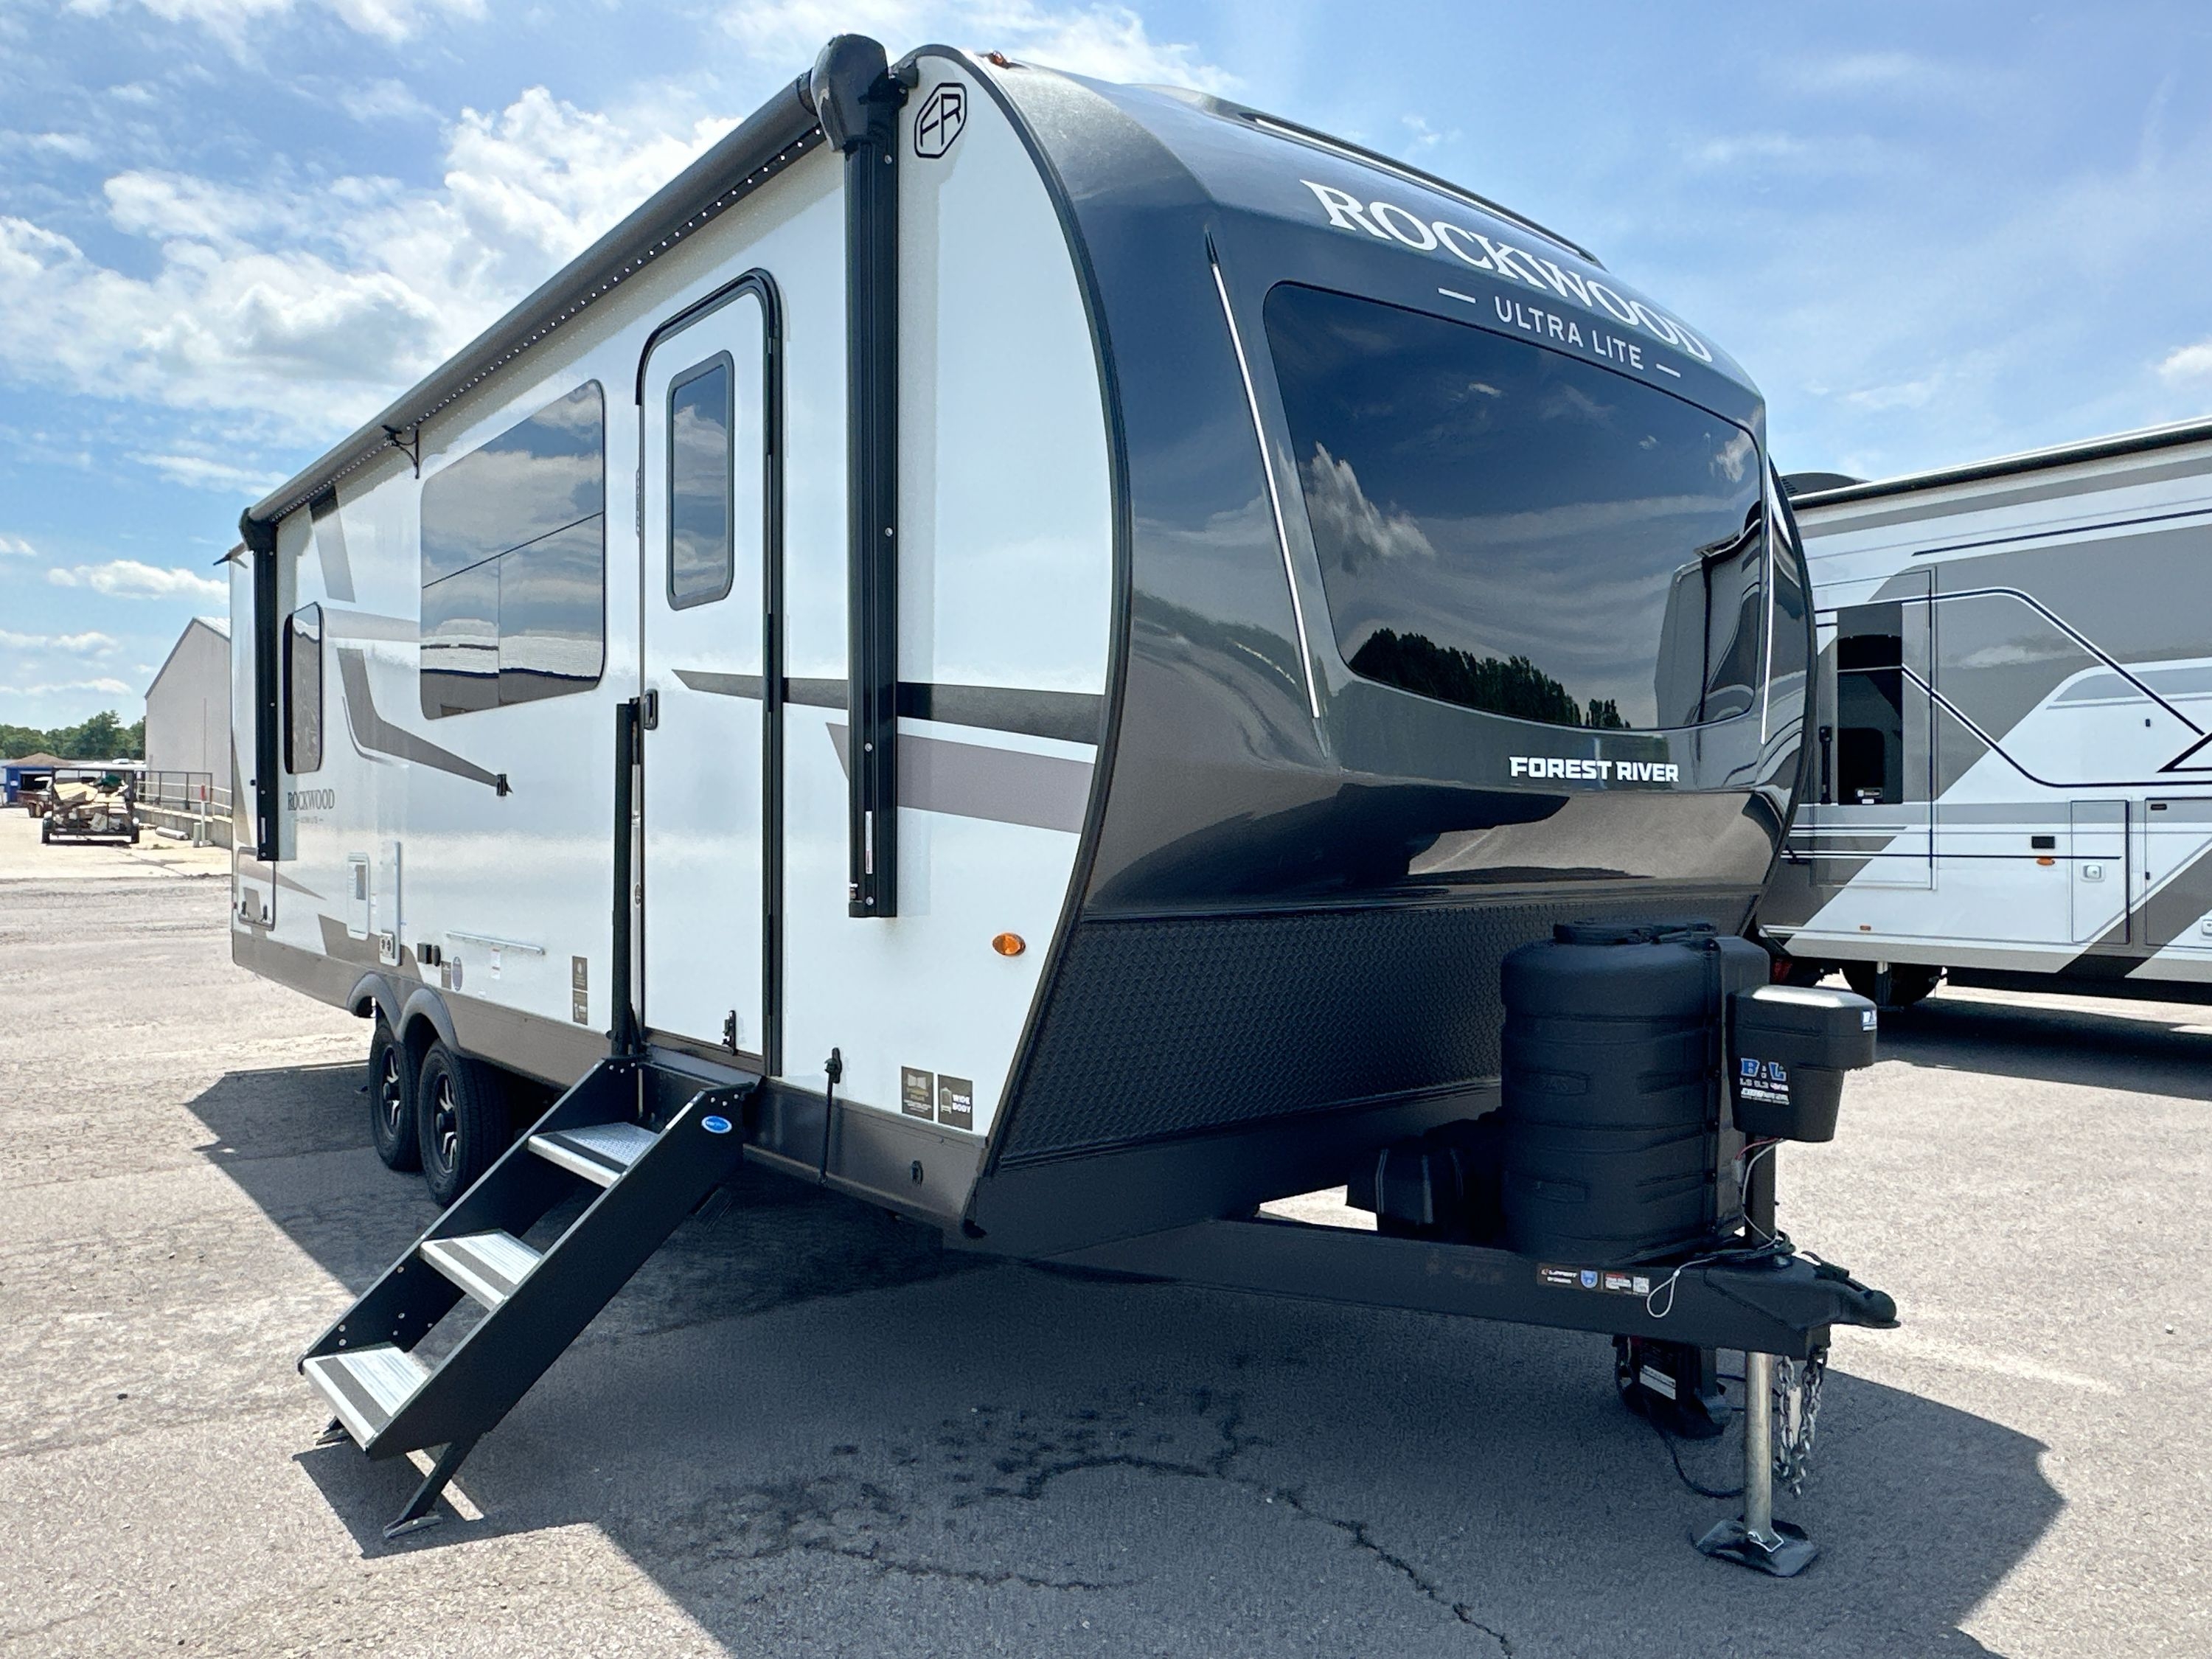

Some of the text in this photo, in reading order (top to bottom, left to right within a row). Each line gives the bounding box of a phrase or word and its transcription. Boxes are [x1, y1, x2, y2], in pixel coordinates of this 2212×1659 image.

[1300, 178, 1713, 364] ROCKWOOD
[1493, 296, 1644, 370] ULTRA LITE
[1509, 757, 1680, 782] FOREST RIVER
[288, 788, 335, 811] ROCKWOOD
